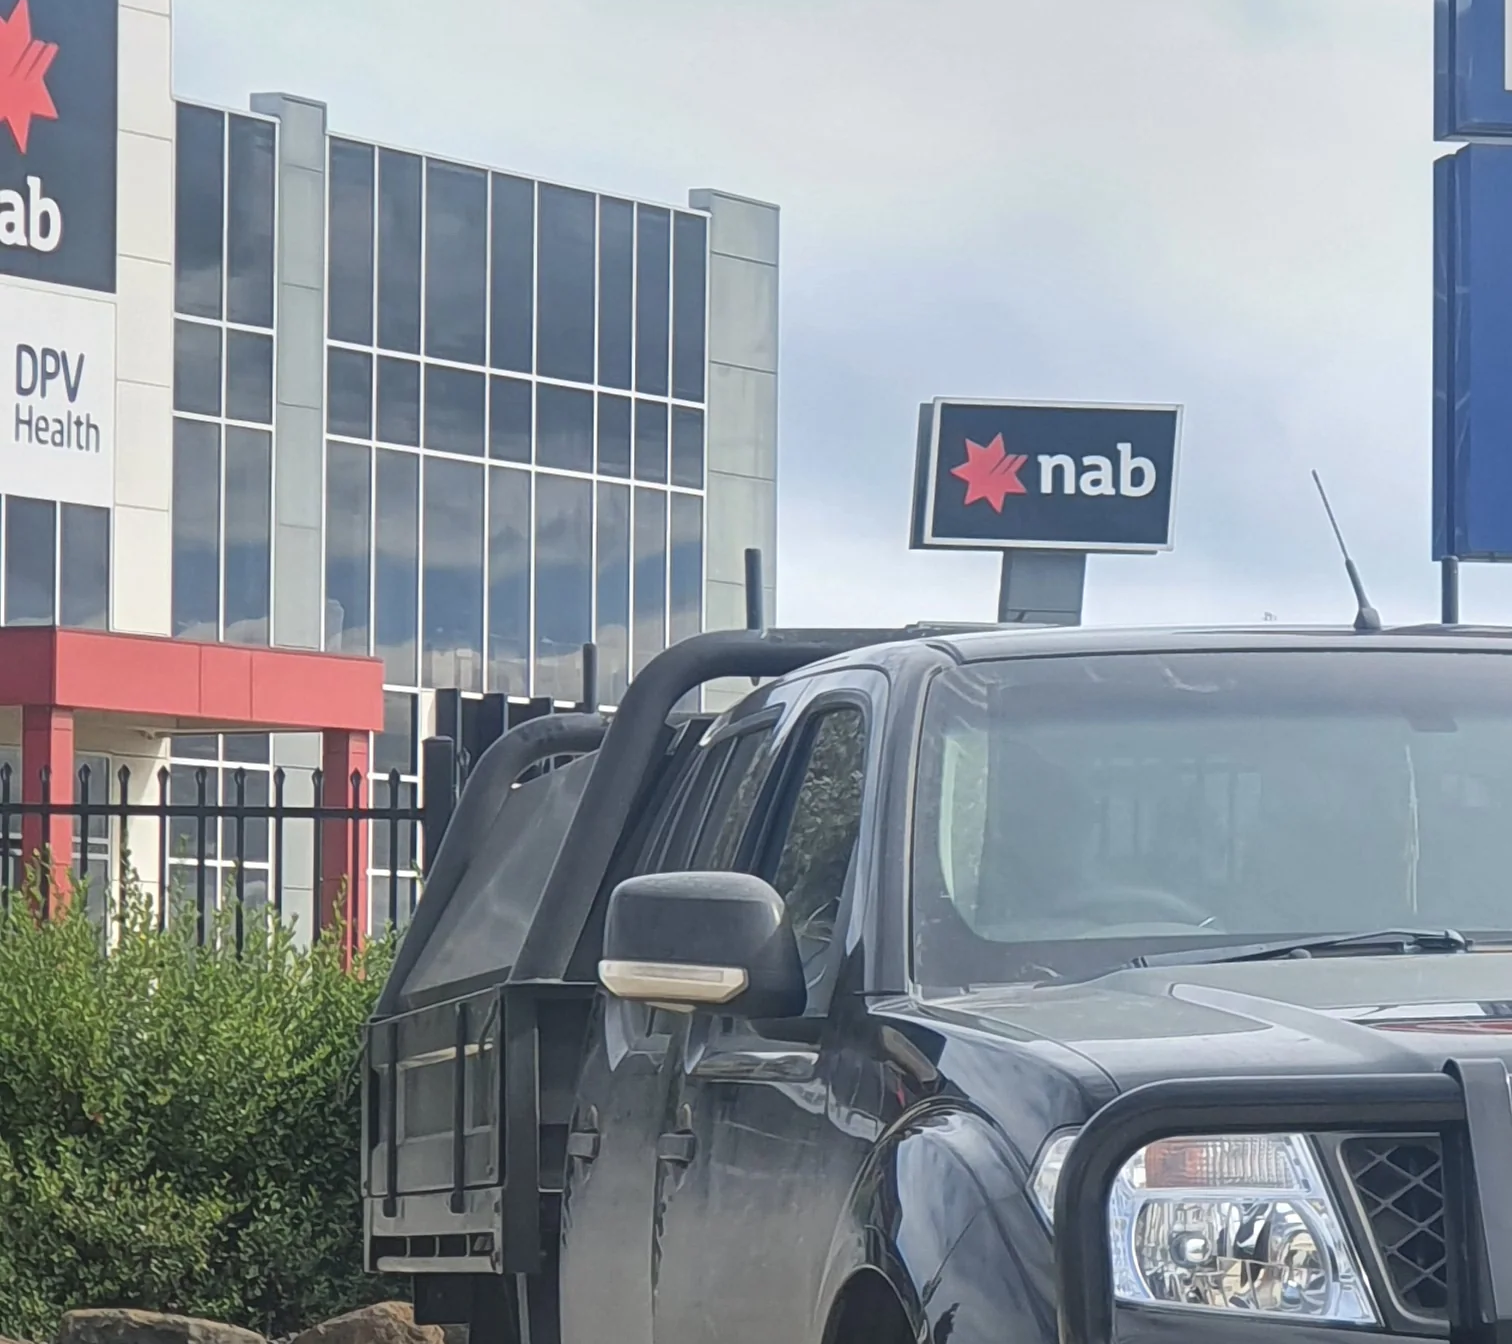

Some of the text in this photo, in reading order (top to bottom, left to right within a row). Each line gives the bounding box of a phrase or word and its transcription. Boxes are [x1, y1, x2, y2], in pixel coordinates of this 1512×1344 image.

[0, 175, 62, 252] ab
[15, 343, 85, 403] DPV
[14, 402, 101, 453] Health
[1036, 442, 1156, 497] nab
